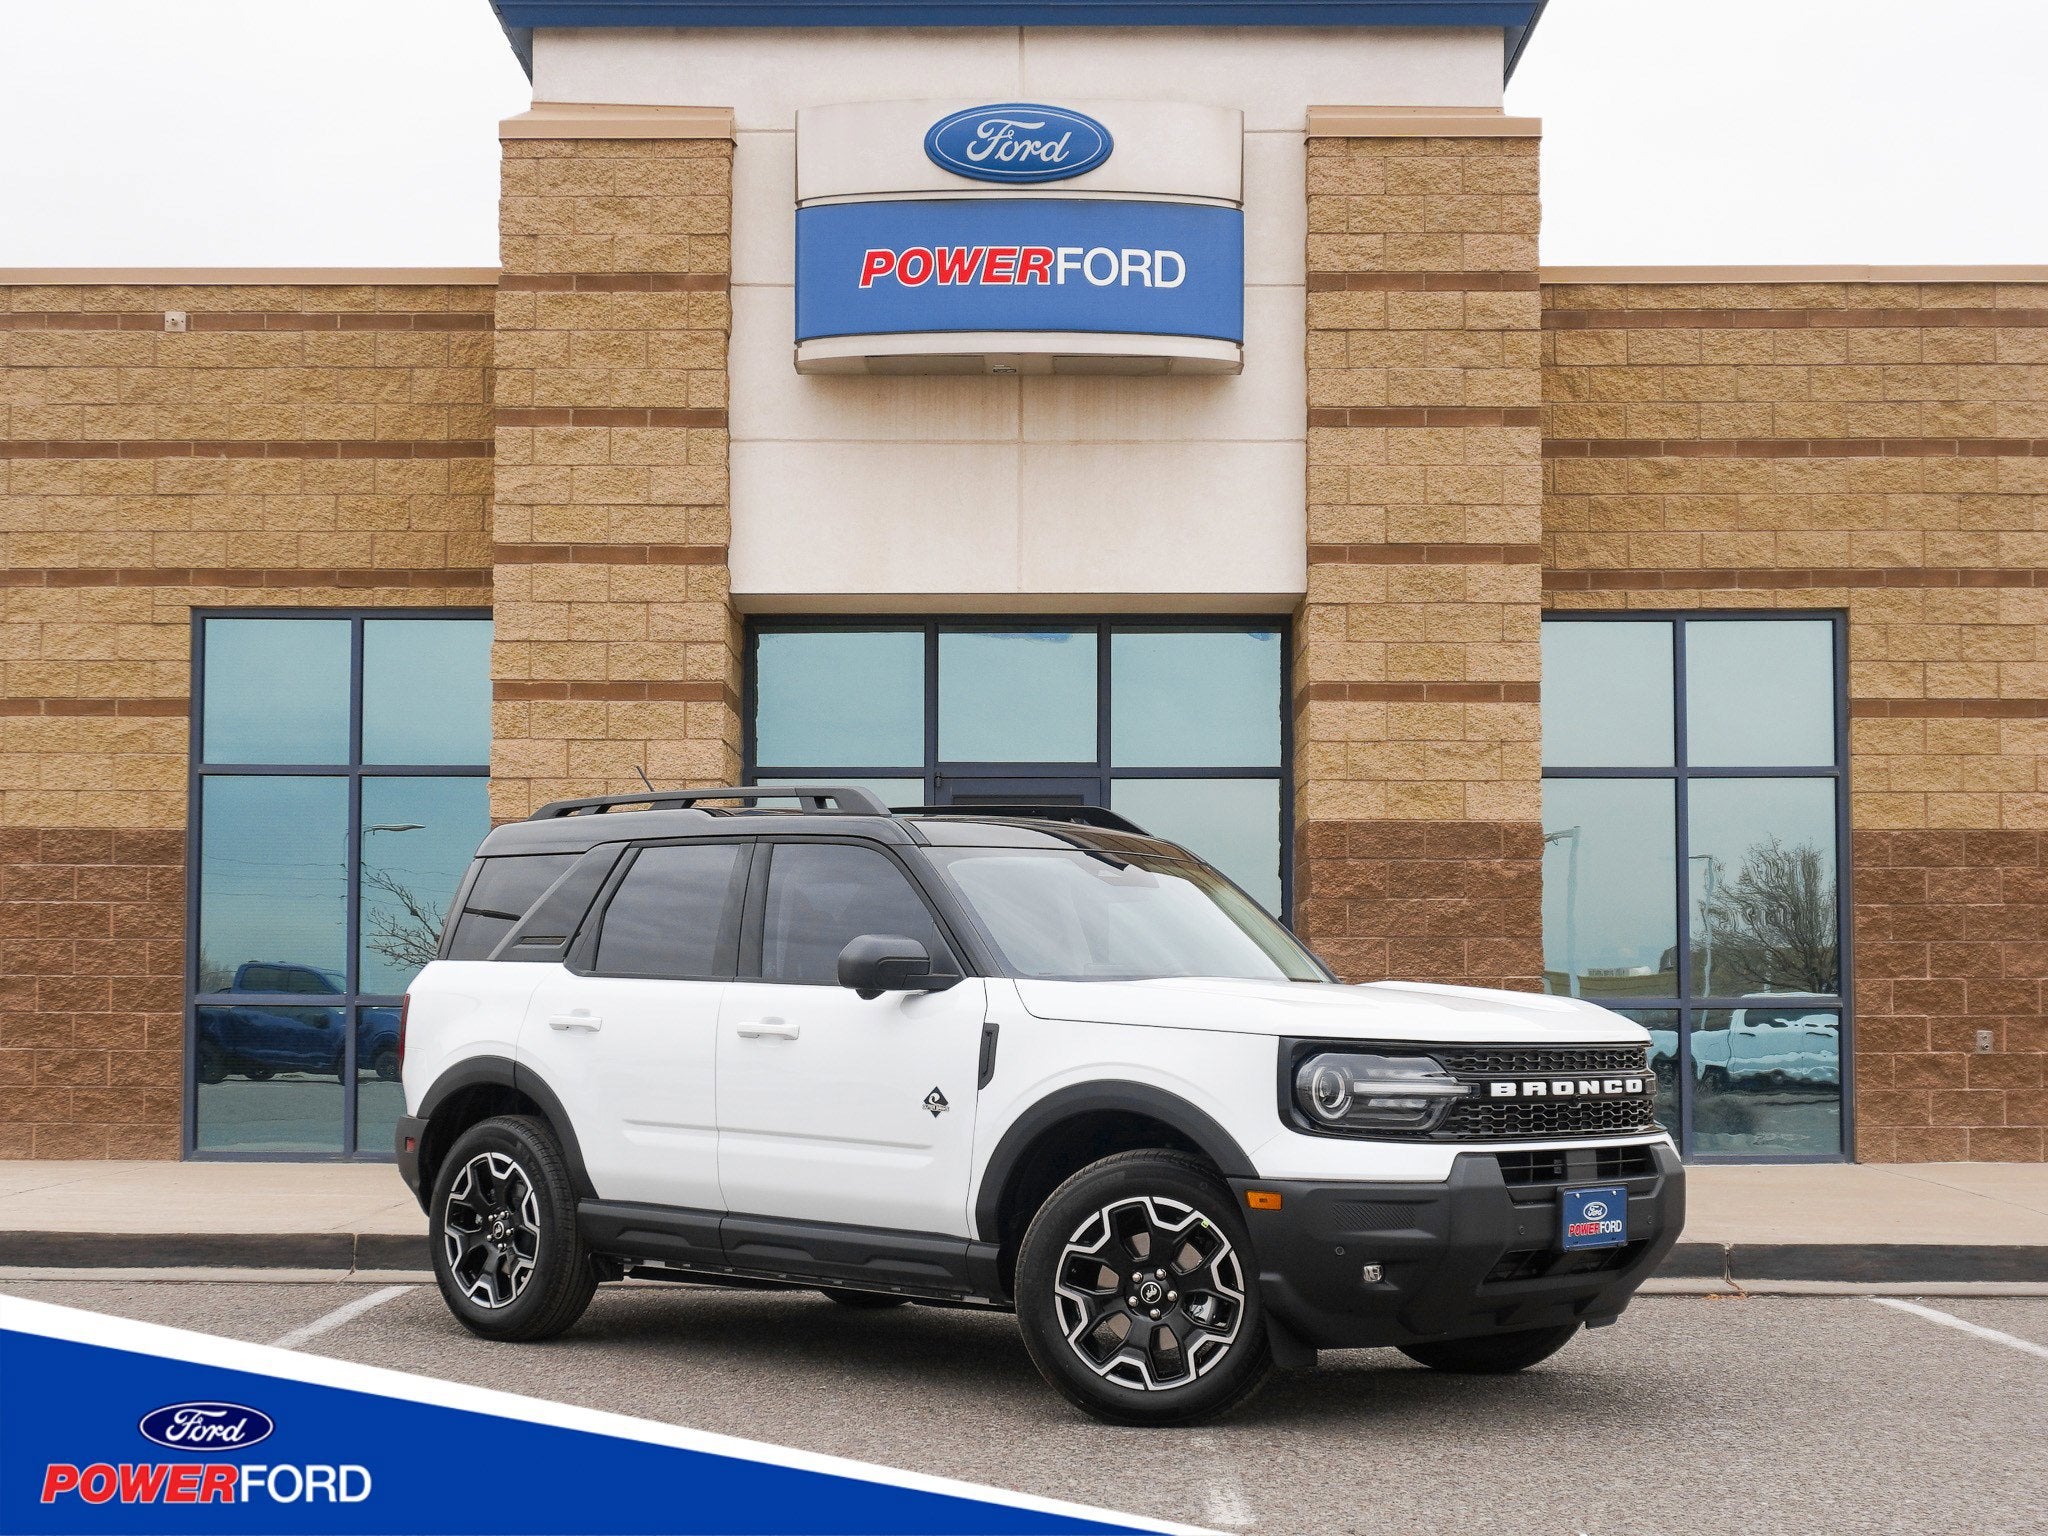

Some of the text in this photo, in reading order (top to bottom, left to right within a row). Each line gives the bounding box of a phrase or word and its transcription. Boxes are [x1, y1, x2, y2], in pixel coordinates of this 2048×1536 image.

[966, 119, 1072, 163] Ford
[1490, 1079, 1643, 1097] BRONCO
[1587, 1205, 1602, 1217] Ford
